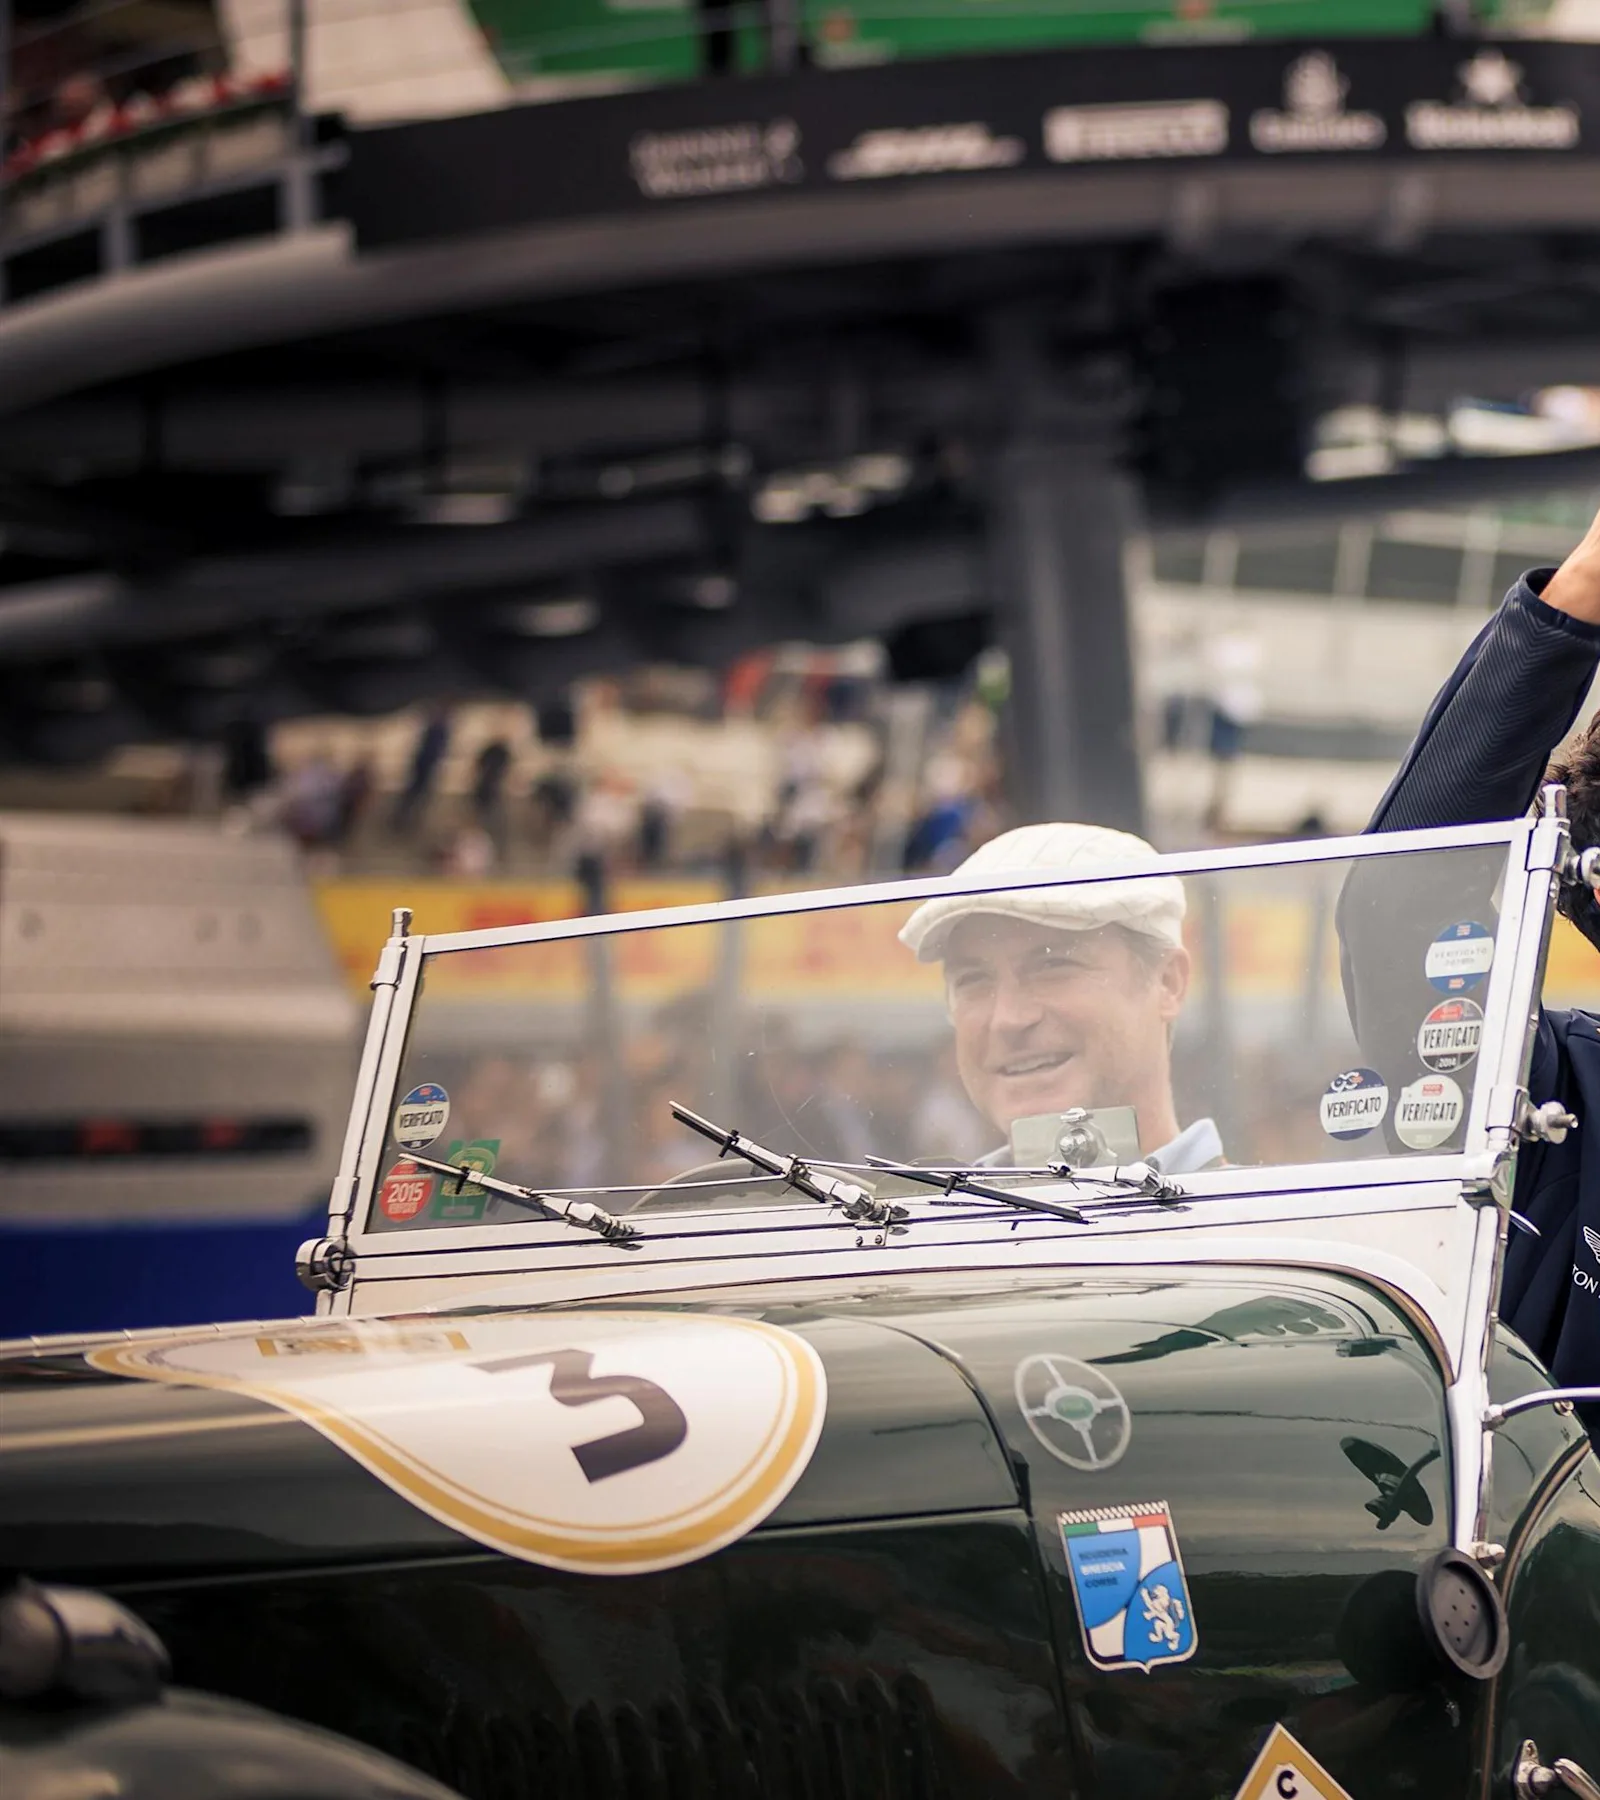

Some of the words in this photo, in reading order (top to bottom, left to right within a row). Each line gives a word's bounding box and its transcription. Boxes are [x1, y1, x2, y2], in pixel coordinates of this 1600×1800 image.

[1424, 1025, 1480, 1049] VERIFICATO
[399, 1109, 444, 1129] VERIFICATO
[1327, 1096, 1381, 1119] VERIFICATO
[1402, 1102, 1457, 1122] VERIFICATO
[387, 1182, 425, 1203] 2015
[466, 1348, 688, 1485] 3
[1276, 1769, 1299, 1800] C
